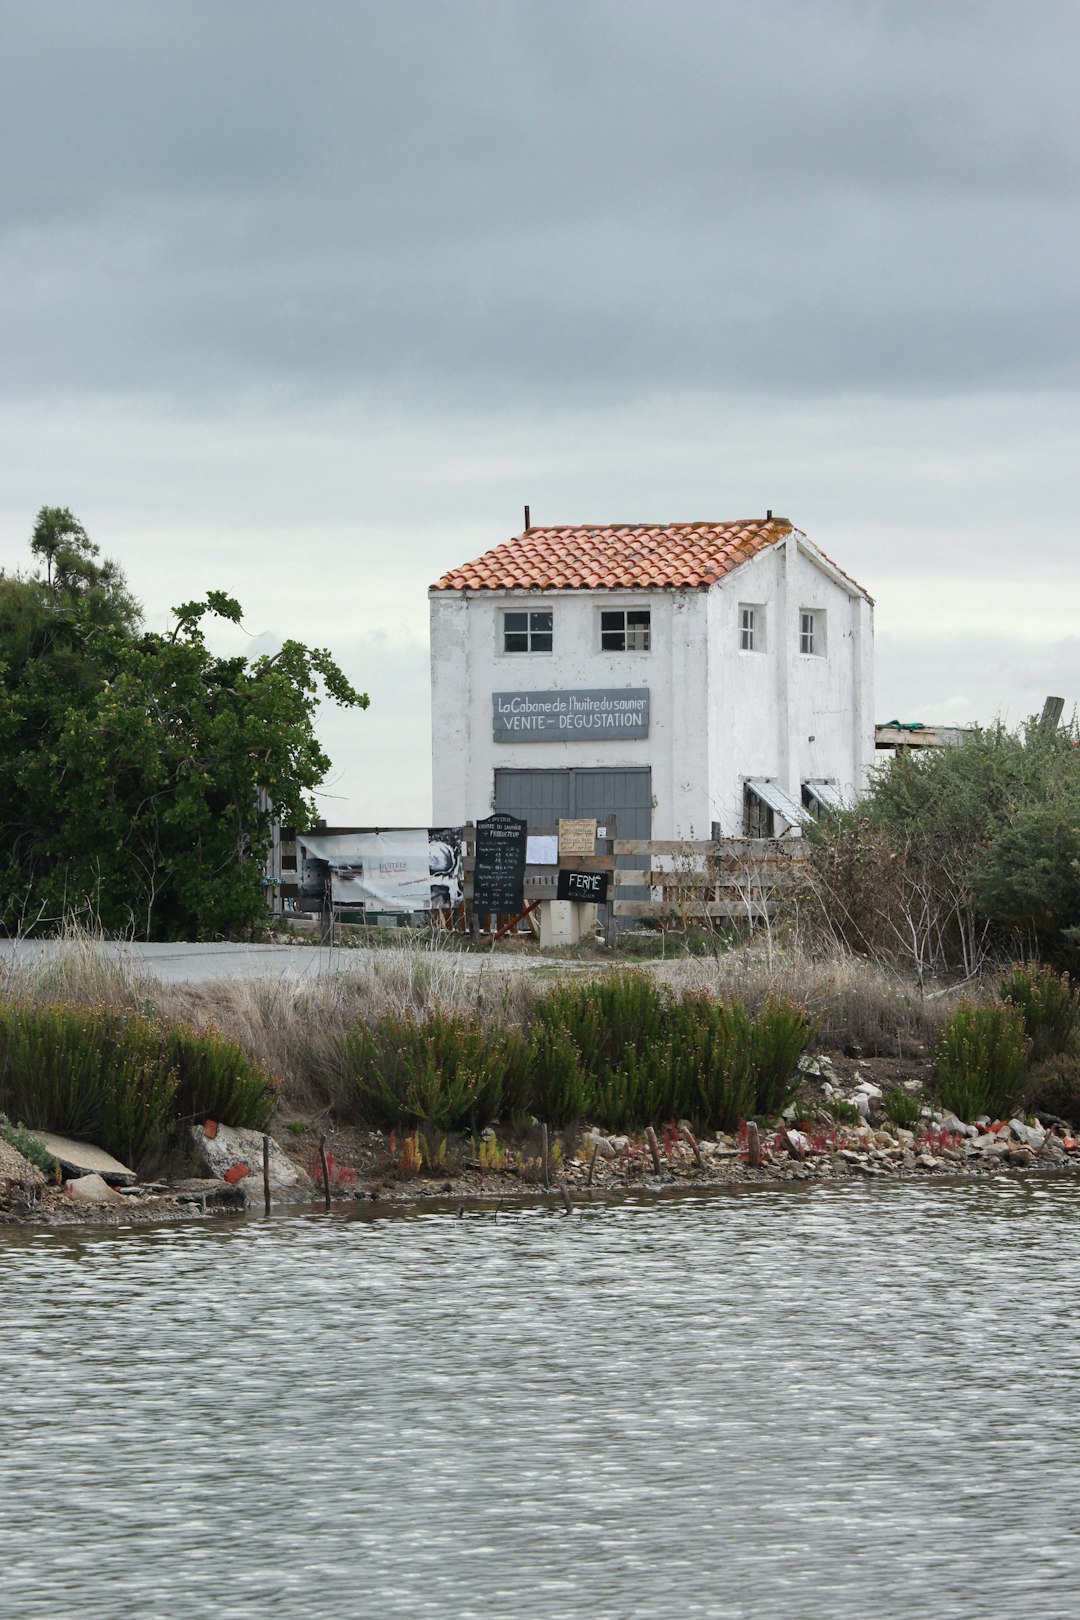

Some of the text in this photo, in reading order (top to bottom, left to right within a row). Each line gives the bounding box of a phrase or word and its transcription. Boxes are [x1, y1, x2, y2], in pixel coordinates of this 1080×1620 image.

[511, 697, 551, 713] Cabane
[614, 698, 647, 710] saunier
[503, 716, 545, 730] VENTE
[559, 712, 642, 729] DÉGUSTATION
